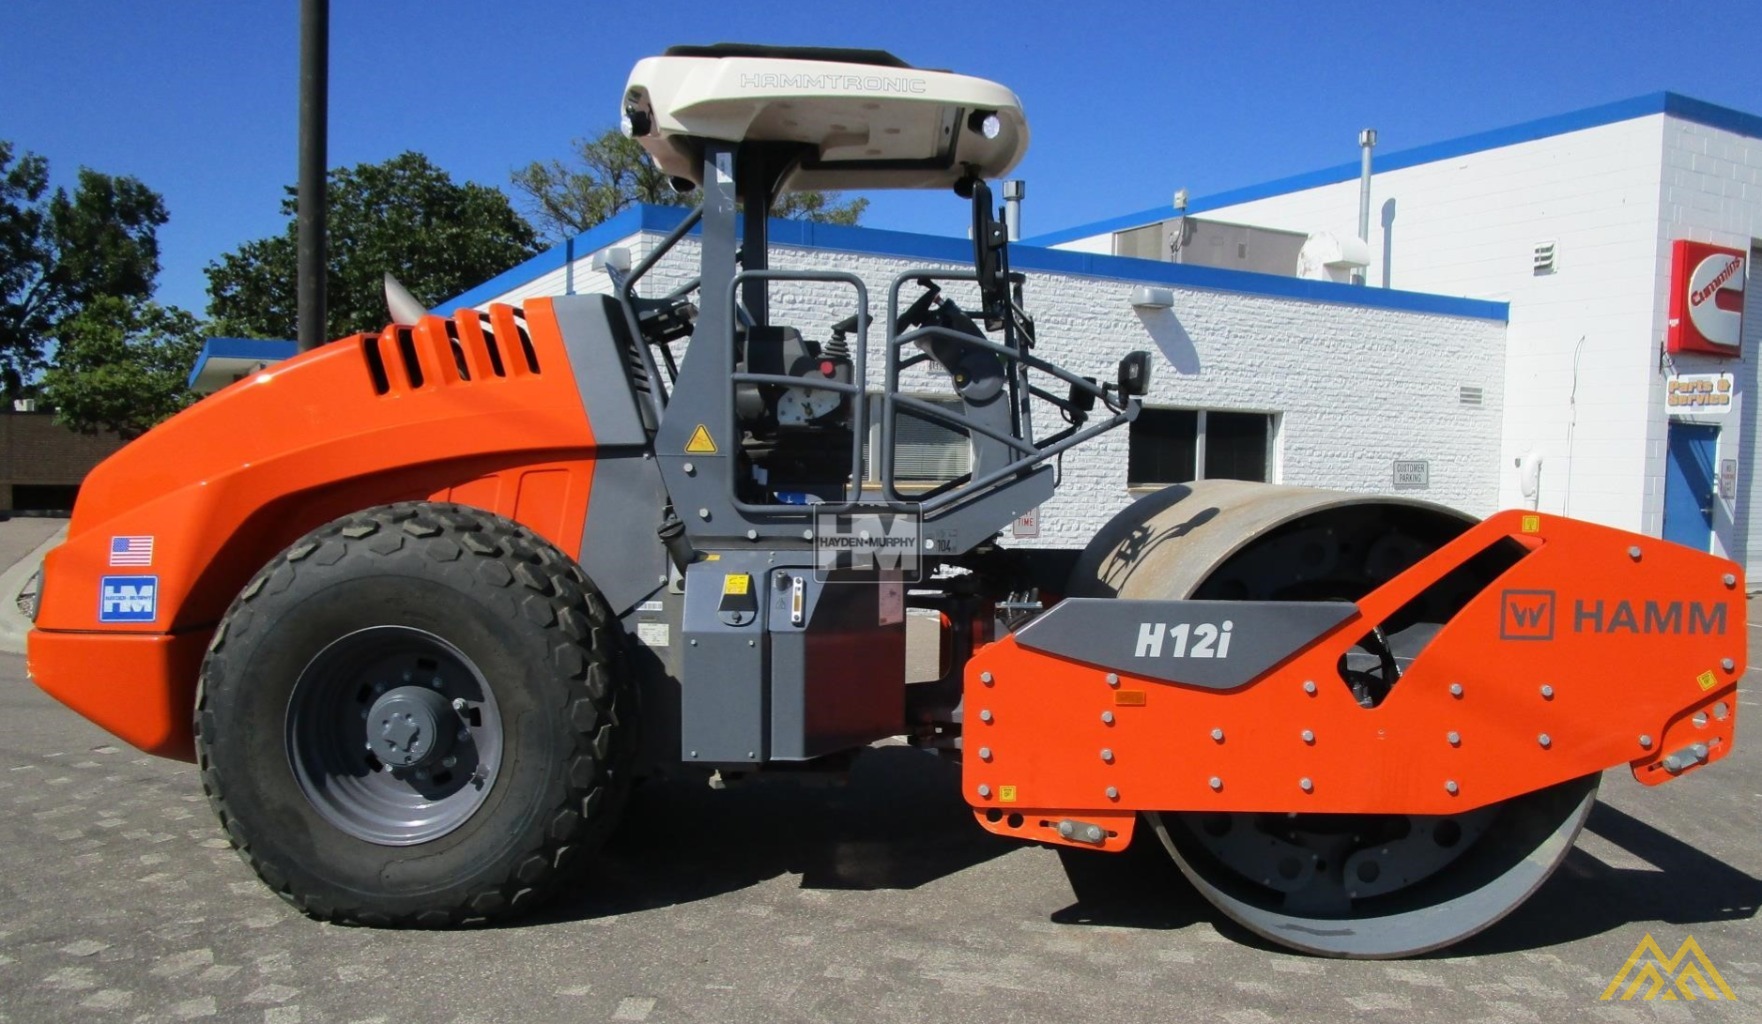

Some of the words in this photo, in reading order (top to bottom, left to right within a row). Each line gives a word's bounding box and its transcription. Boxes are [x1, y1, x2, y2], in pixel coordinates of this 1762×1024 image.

[740, 73, 927, 94] HAMMTRONIC
[1691, 257, 1741, 307] Cummins
[1668, 380, 1713, 394] Parts
[1668, 394, 1730, 407] Service
[1397, 464, 1425, 473] CUSTOMER
[1400, 474, 1421, 482] PARKING
[1018, 517, 1034, 527] TIME
[104, 586, 153, 612] HM
[1574, 600, 1728, 635] HAMM
[1134, 620, 1234, 658] H12i
